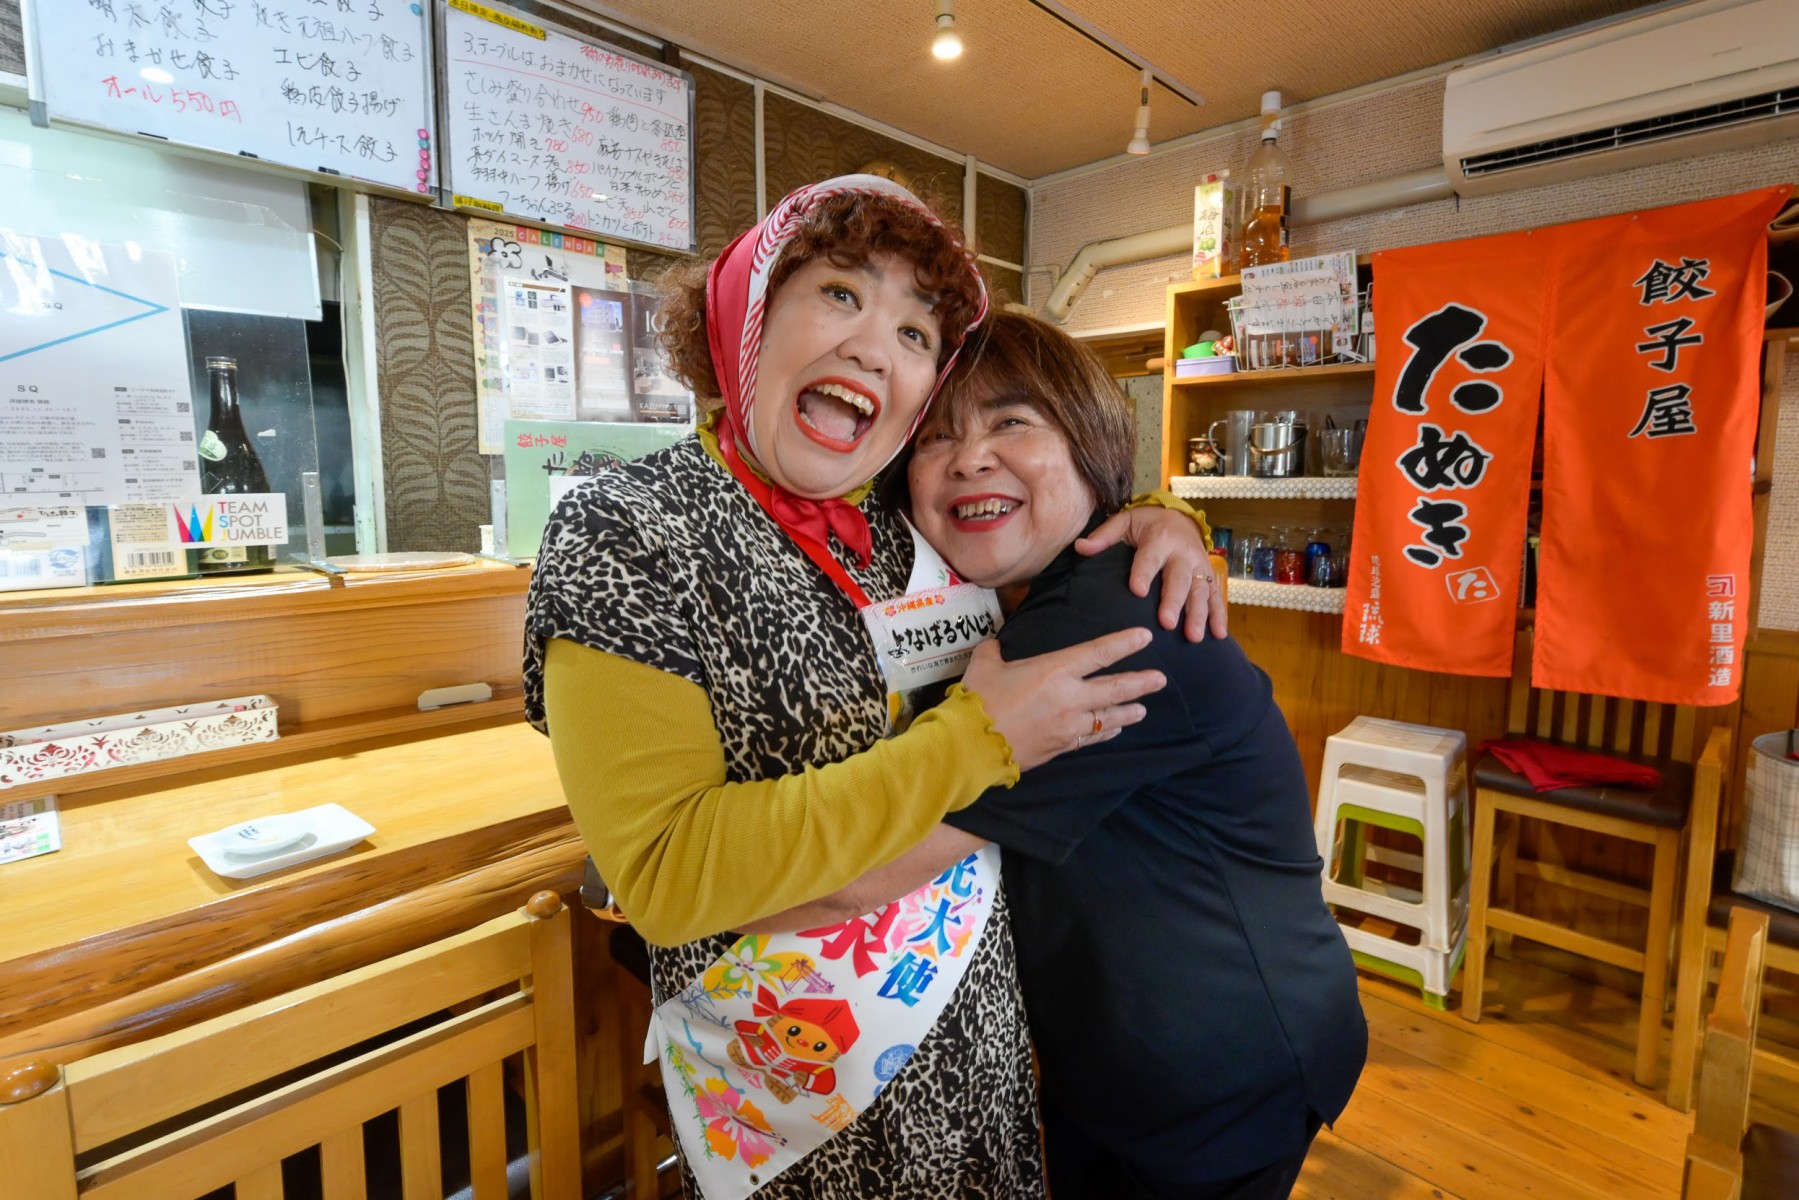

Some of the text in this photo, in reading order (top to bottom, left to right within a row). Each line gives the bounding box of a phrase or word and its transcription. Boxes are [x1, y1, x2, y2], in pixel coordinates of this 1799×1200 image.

[91, 33, 240, 81] おまかせ餃子
[273, 49, 362, 82] エビ餃子
[494, 227, 604, 255] 2025 CALENDAR
[1628, 257, 1716, 440] 餃子屋
[517, 432, 567, 449] 餃子屋
[1392, 302, 1514, 569] たぬき
[217, 501, 268, 514] TEAM
[219, 514, 263, 528] SPOT
[219, 527, 283, 541] JUMBLE
[1457, 573, 1487, 600] た
[1359, 601, 1385, 645] 琉球
[1708, 600, 1735, 686] 新里酒造
